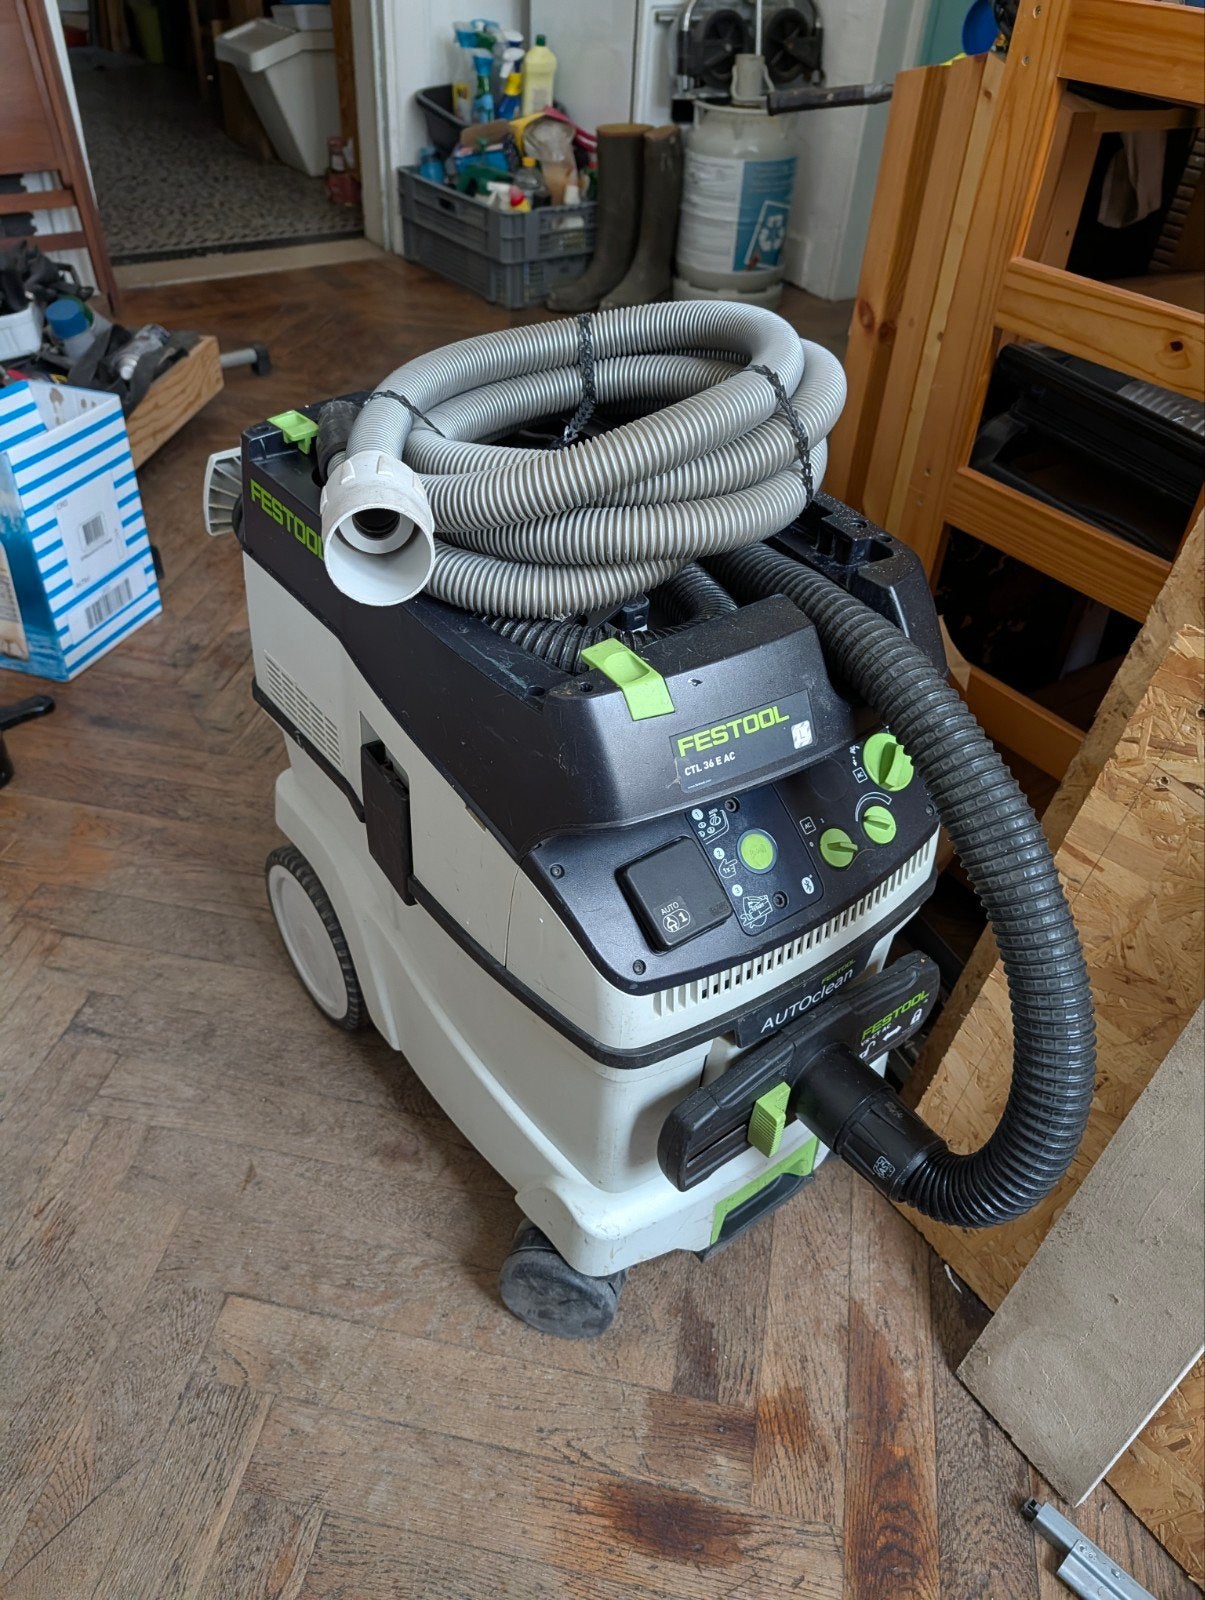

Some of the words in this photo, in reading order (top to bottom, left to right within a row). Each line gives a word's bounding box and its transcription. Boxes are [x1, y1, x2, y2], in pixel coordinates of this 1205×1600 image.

[677, 706, 790, 757] FESTOOL
[685, 762, 703, 776] CTL
[703, 757, 715, 770] 36
[715, 755, 723, 766] E
[724, 751, 736, 764] AC
[660, 901, 680, 917] AUTO
[678, 912, 689, 924] 1
[821, 959, 856, 984] FESTOOL
[760, 968, 854, 1034] AUTOclean
[861, 990, 930, 1041] FESTOOL
